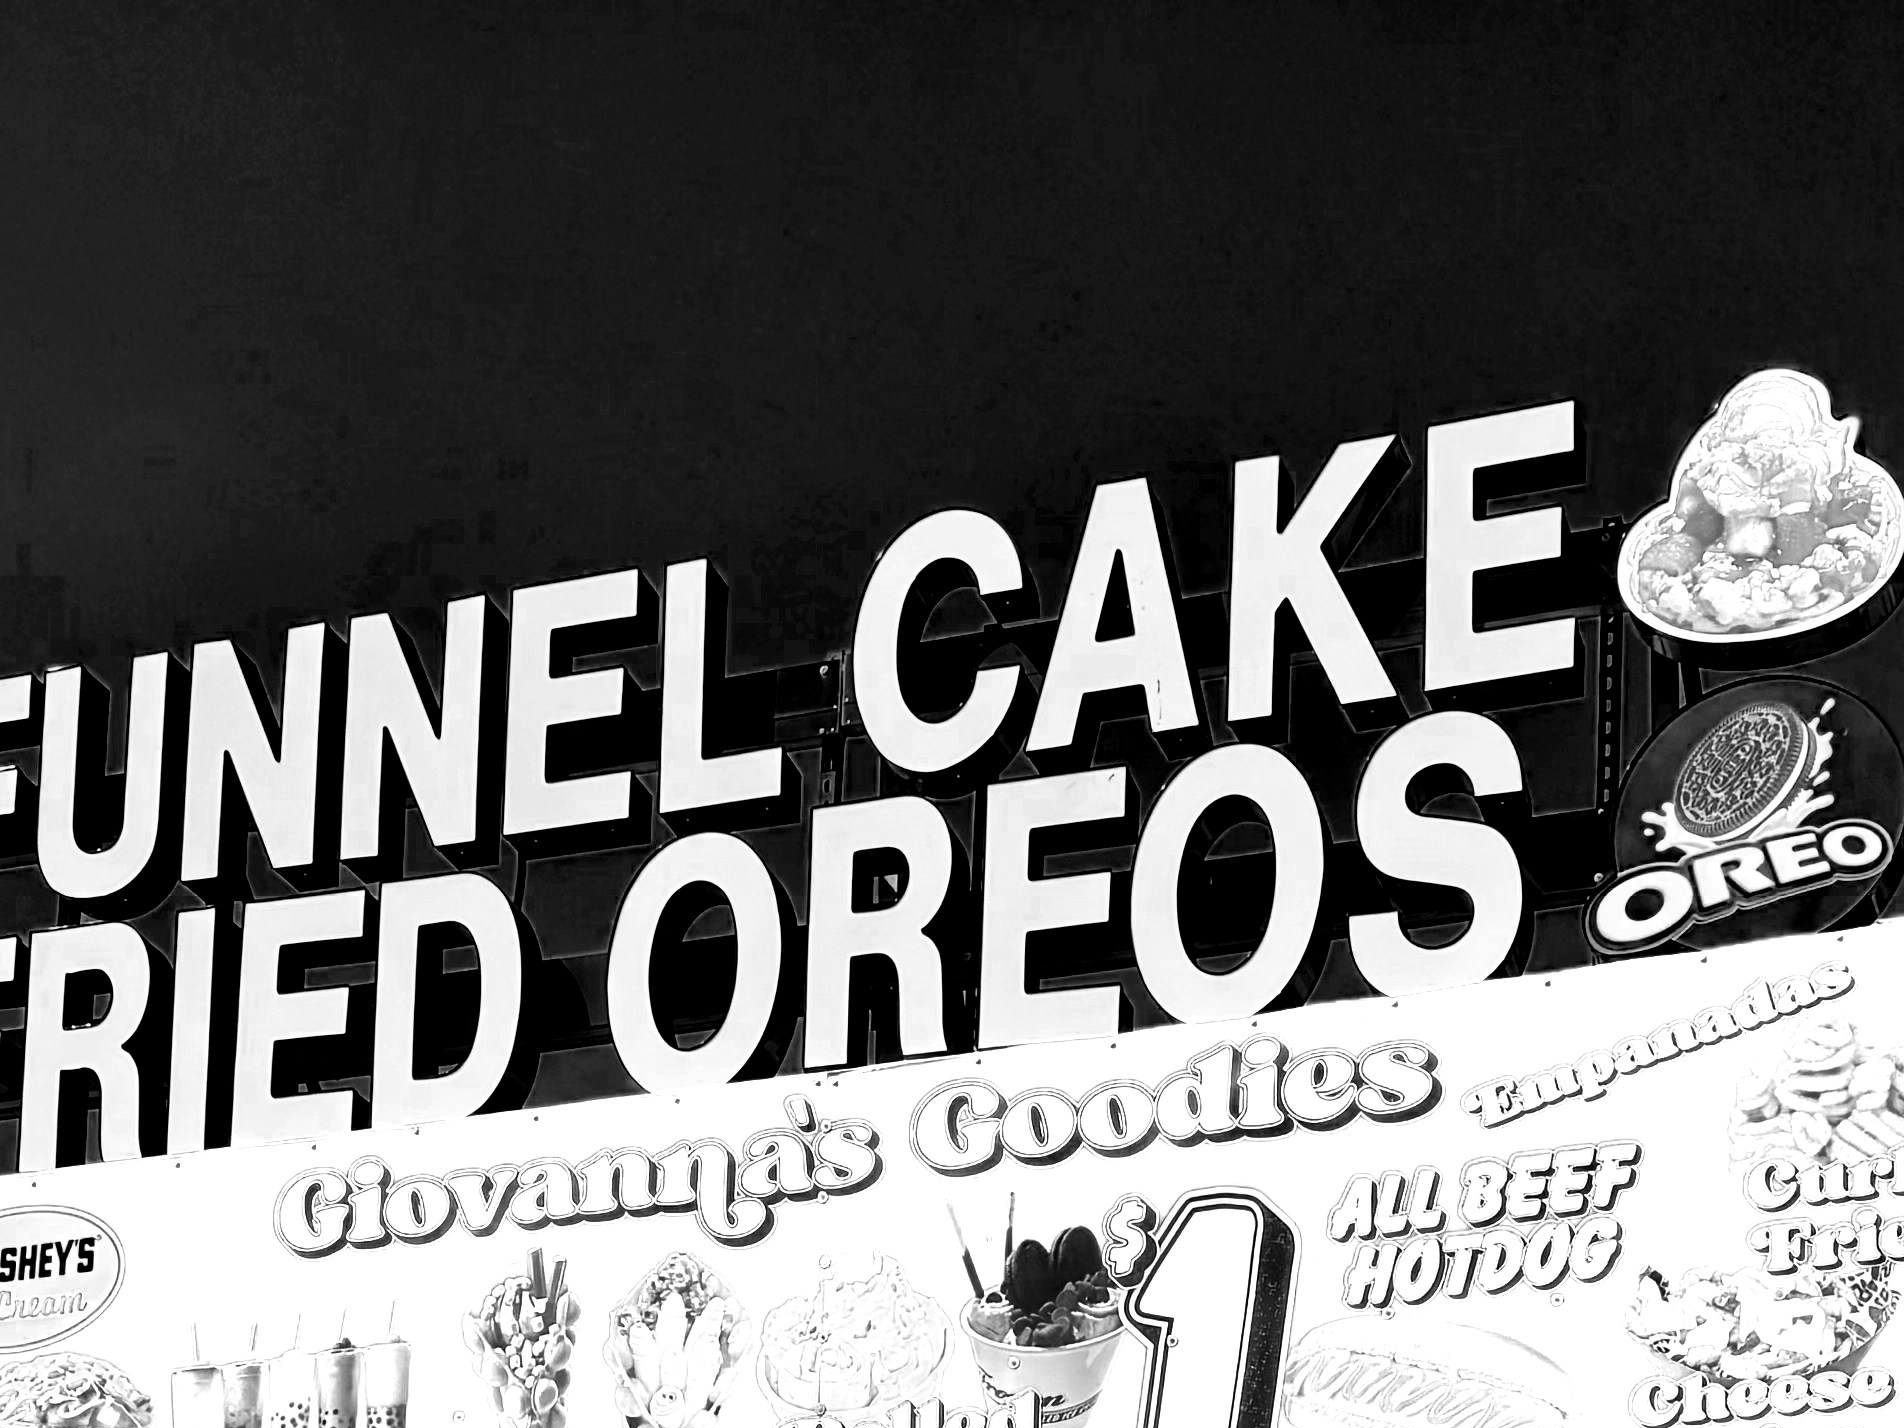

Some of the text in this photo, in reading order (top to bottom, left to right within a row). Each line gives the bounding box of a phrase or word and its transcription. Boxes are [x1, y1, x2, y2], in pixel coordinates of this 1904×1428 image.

[851, 398, 1585, 778] CAKE
[608, 711, 1527, 1095] OREOS
[1592, 817, 1888, 947] OREO
[1463, 959, 1855, 1129] Empanadas
[274, 1035, 1443, 1258] Giovanna's Goodies
[1327, 1141, 1644, 1244] ALL BEEF
[1344, 1214, 1623, 1309] HOTDOG
